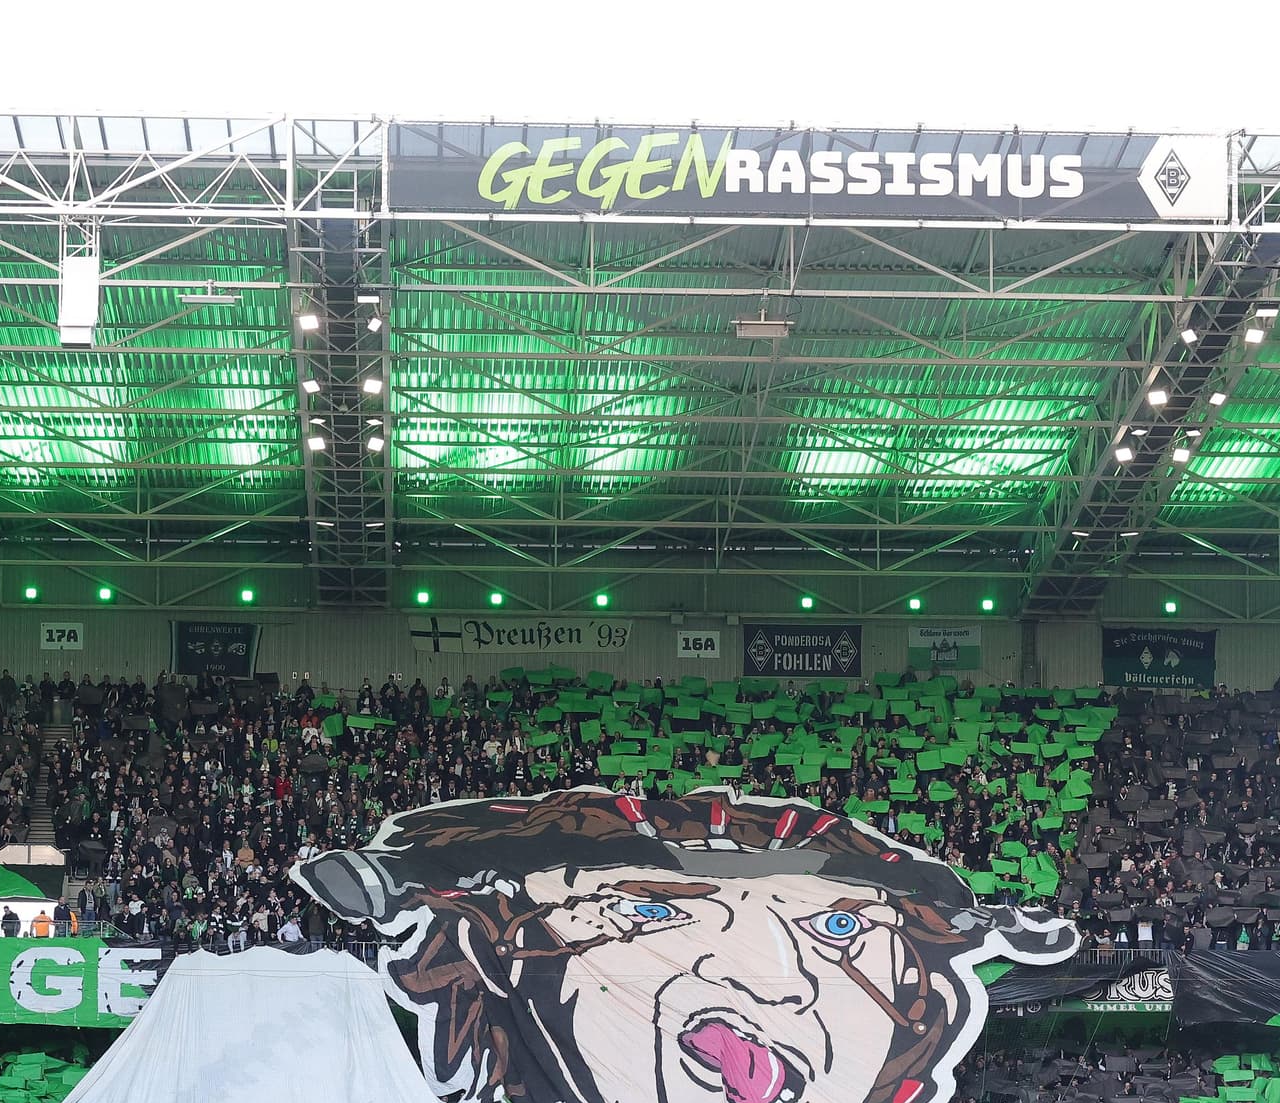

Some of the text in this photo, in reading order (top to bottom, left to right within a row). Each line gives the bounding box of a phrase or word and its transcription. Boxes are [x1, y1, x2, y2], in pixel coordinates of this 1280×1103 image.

[476, 130, 1086, 208] GEGEN RASSISMUS
[45, 629, 79, 642] 17A
[464, 621, 583, 651] Preußen
[774, 635, 831, 647] PONDEROSA
[682, 637, 716, 651] 16A
[774, 653, 832, 671] FOHLEN
